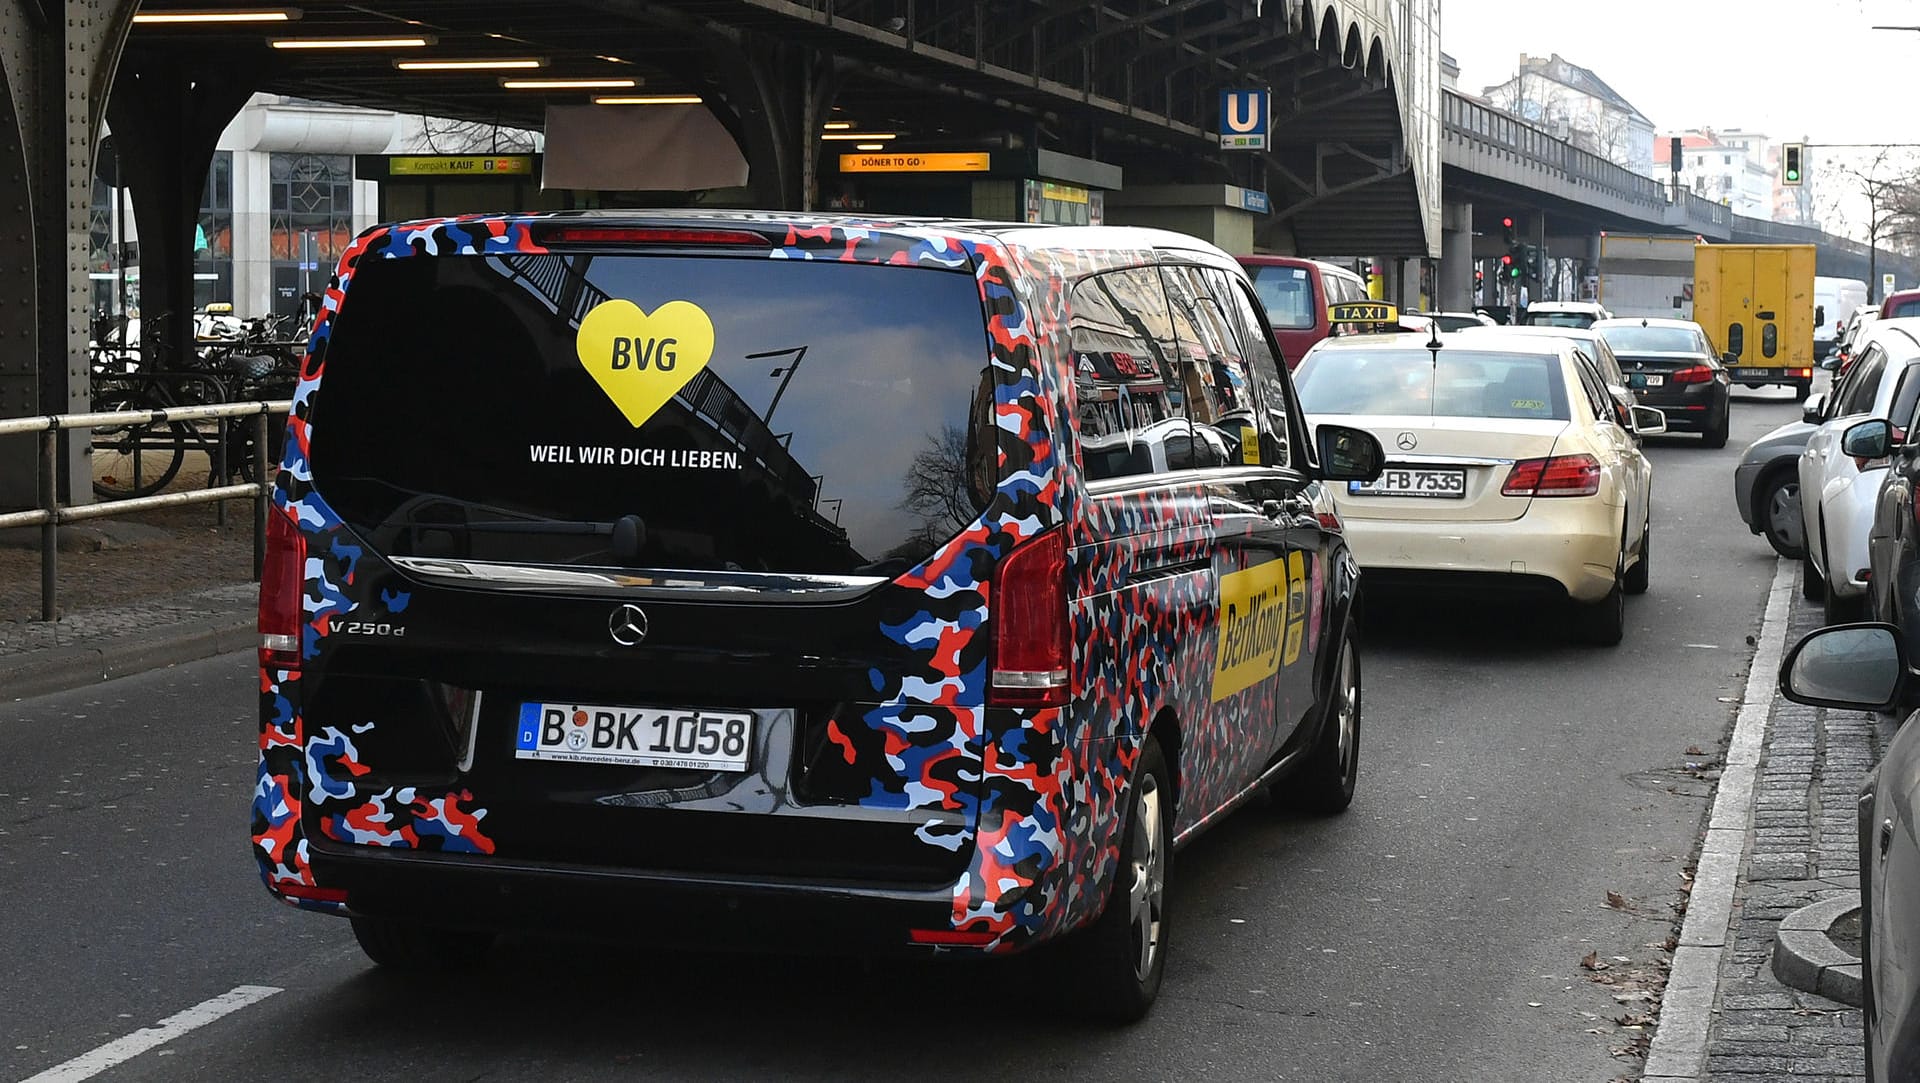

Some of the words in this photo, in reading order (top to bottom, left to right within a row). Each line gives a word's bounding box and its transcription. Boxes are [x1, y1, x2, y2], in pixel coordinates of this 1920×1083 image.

[1227, 93, 1259, 132] U
[414, 161, 447, 172] Kompakt
[450, 160, 474, 170] KAUF
[861, 157, 891, 166] DÖNER
[894, 157, 904, 166] TO
[907, 157, 920, 166] GO
[1341, 308, 1382, 318] TAXI
[611, 337, 677, 371] BVG
[530, 445, 574, 463] WEIL
[578, 447, 615, 465] WIR
[620, 448, 665, 467] DICH
[671, 450, 742, 470] LIEBEN.
[1386, 472, 1411, 489] FB
[1415, 473, 1462, 490] 7535
[329, 621, 344, 632] V
[348, 622, 390, 635] 250
[393, 627, 405, 636] d
[1221, 584, 1283, 672] BerlKönig
[523, 731, 532, 743] D
[541, 709, 566, 746] B
[592, 712, 643, 751] BK
[650, 715, 746, 757] 1058
